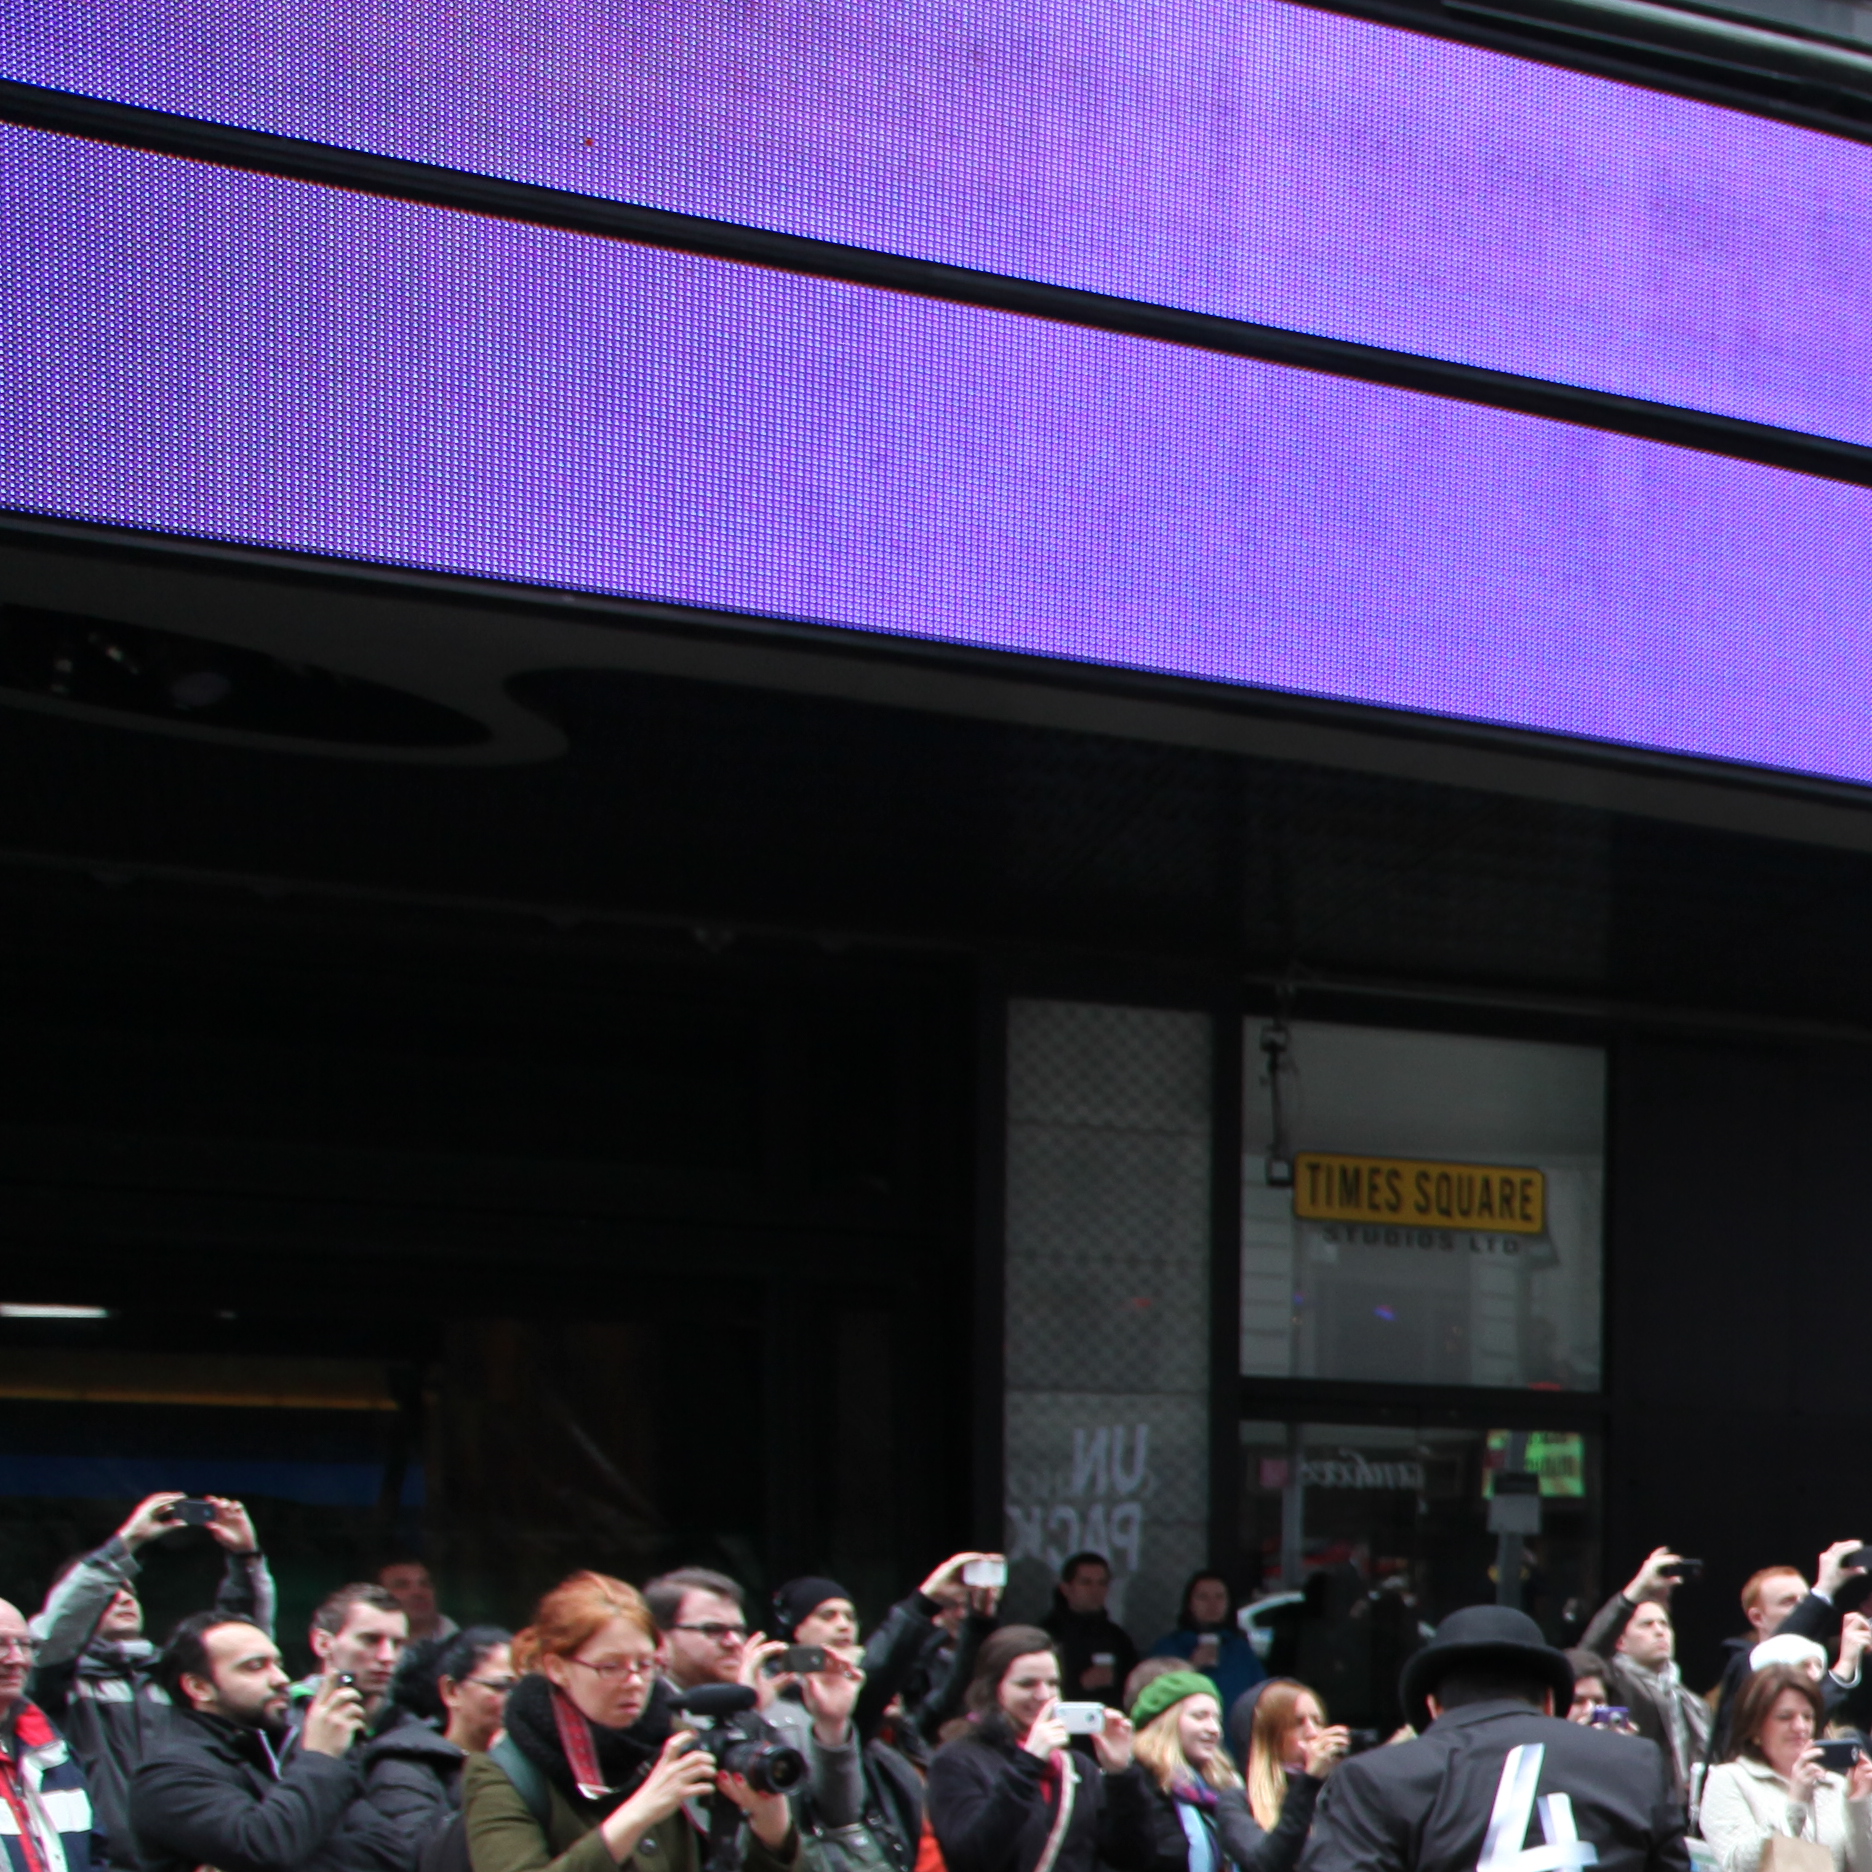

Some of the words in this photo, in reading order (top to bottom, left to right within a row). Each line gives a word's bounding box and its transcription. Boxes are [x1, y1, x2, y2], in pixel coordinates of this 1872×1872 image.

[1305, 1162, 1403, 1213] TIMES
[1414, 1169, 1535, 1222] SQUARE
[1323, 1226, 1455, 1252] STUDIOS
